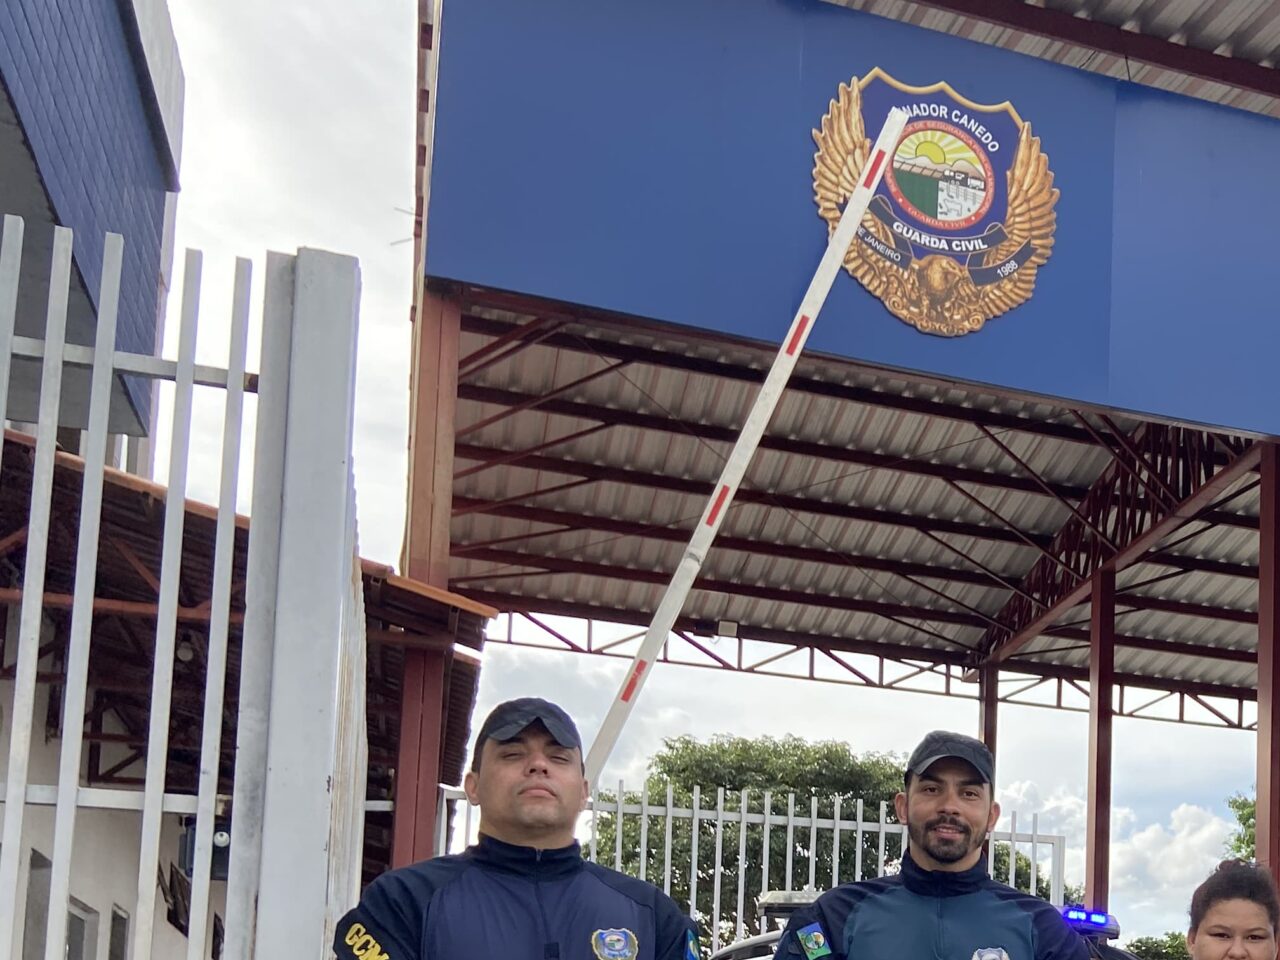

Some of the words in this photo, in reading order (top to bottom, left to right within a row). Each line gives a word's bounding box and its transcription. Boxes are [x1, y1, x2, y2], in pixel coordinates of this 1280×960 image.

[951, 110, 1000, 152] CANEDO
[864, 235, 901, 262] JANEIRO
[892, 221, 949, 250] GUARDA
[951, 238, 988, 252] CIVIL
[997, 260, 1018, 278] 1988
